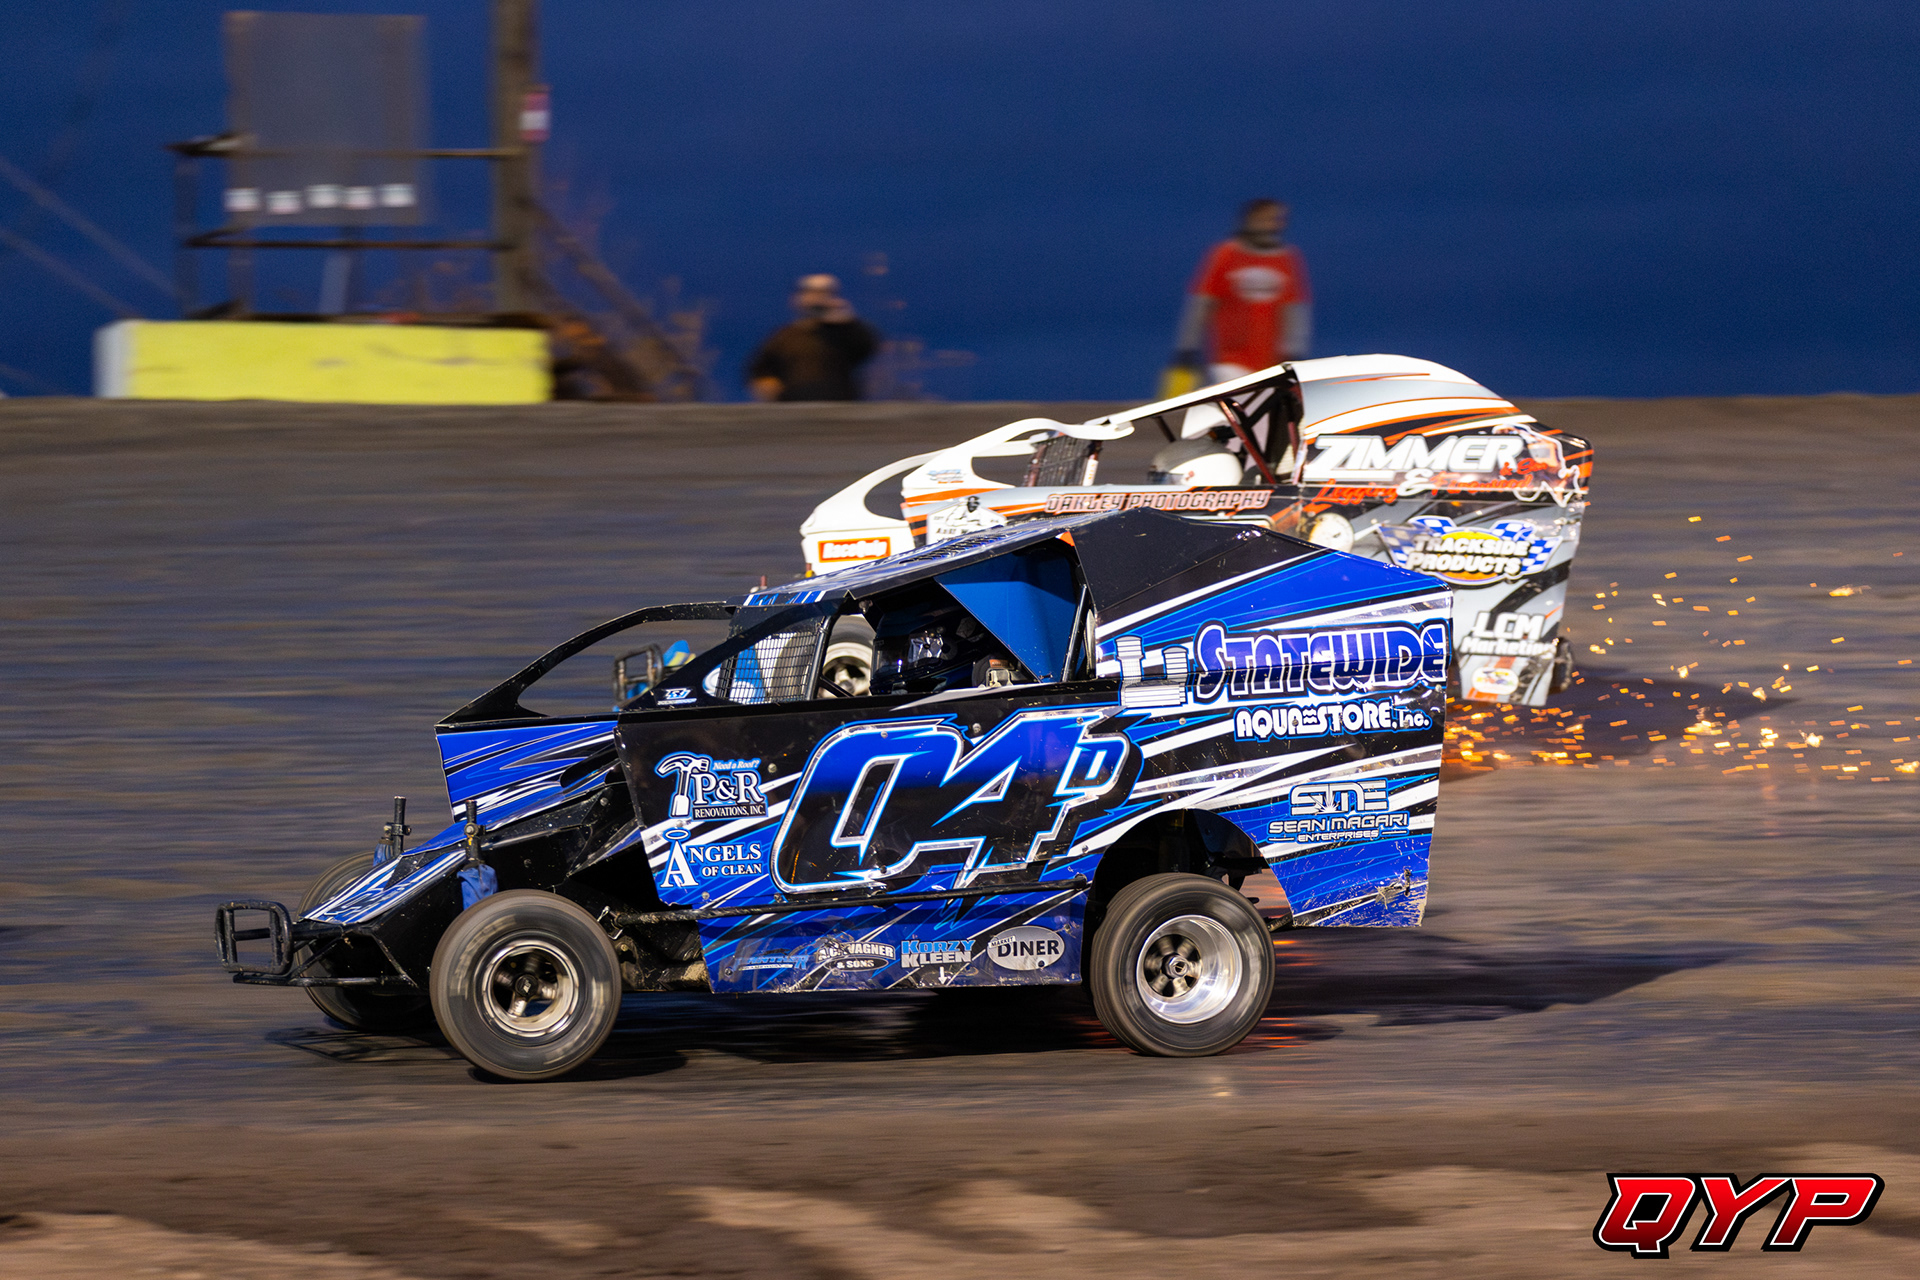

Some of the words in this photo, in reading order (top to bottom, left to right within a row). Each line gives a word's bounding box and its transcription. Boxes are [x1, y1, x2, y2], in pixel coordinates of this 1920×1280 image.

[1303, 434, 1524, 480] ZIMMER
[1044, 493, 1123, 512] OAKLEY
[1124, 490, 1271, 511] PHOTOGRAPHY
[1312, 478, 1398, 504] Logging
[1414, 536, 1530, 557] TRACKSIDE
[1405, 551, 1522, 575] PRODUCTS
[1472, 611, 1545, 640] LCM
[1195, 624, 1448, 699] STATEWIDE
[691, 771, 764, 805] P&R
[694, 806, 750, 818] RENOVATIONS,
[750, 804, 766, 815] INC.
[1269, 818, 1326, 834] SEAN
[1330, 813, 1408, 830] MAGARI
[1297, 829, 1379, 842] ENTERPRISES
[701, 866, 719, 877] OF
[721, 864, 762, 876] CLEAN
[901, 940, 976, 954] KORZY
[990, 937, 1014, 949] MARKET
[997, 939, 1060, 958] DINER
[836, 960, 846, 969] &
[847, 959, 875, 969] SONS
[901, 951, 973, 968] KLEEN
